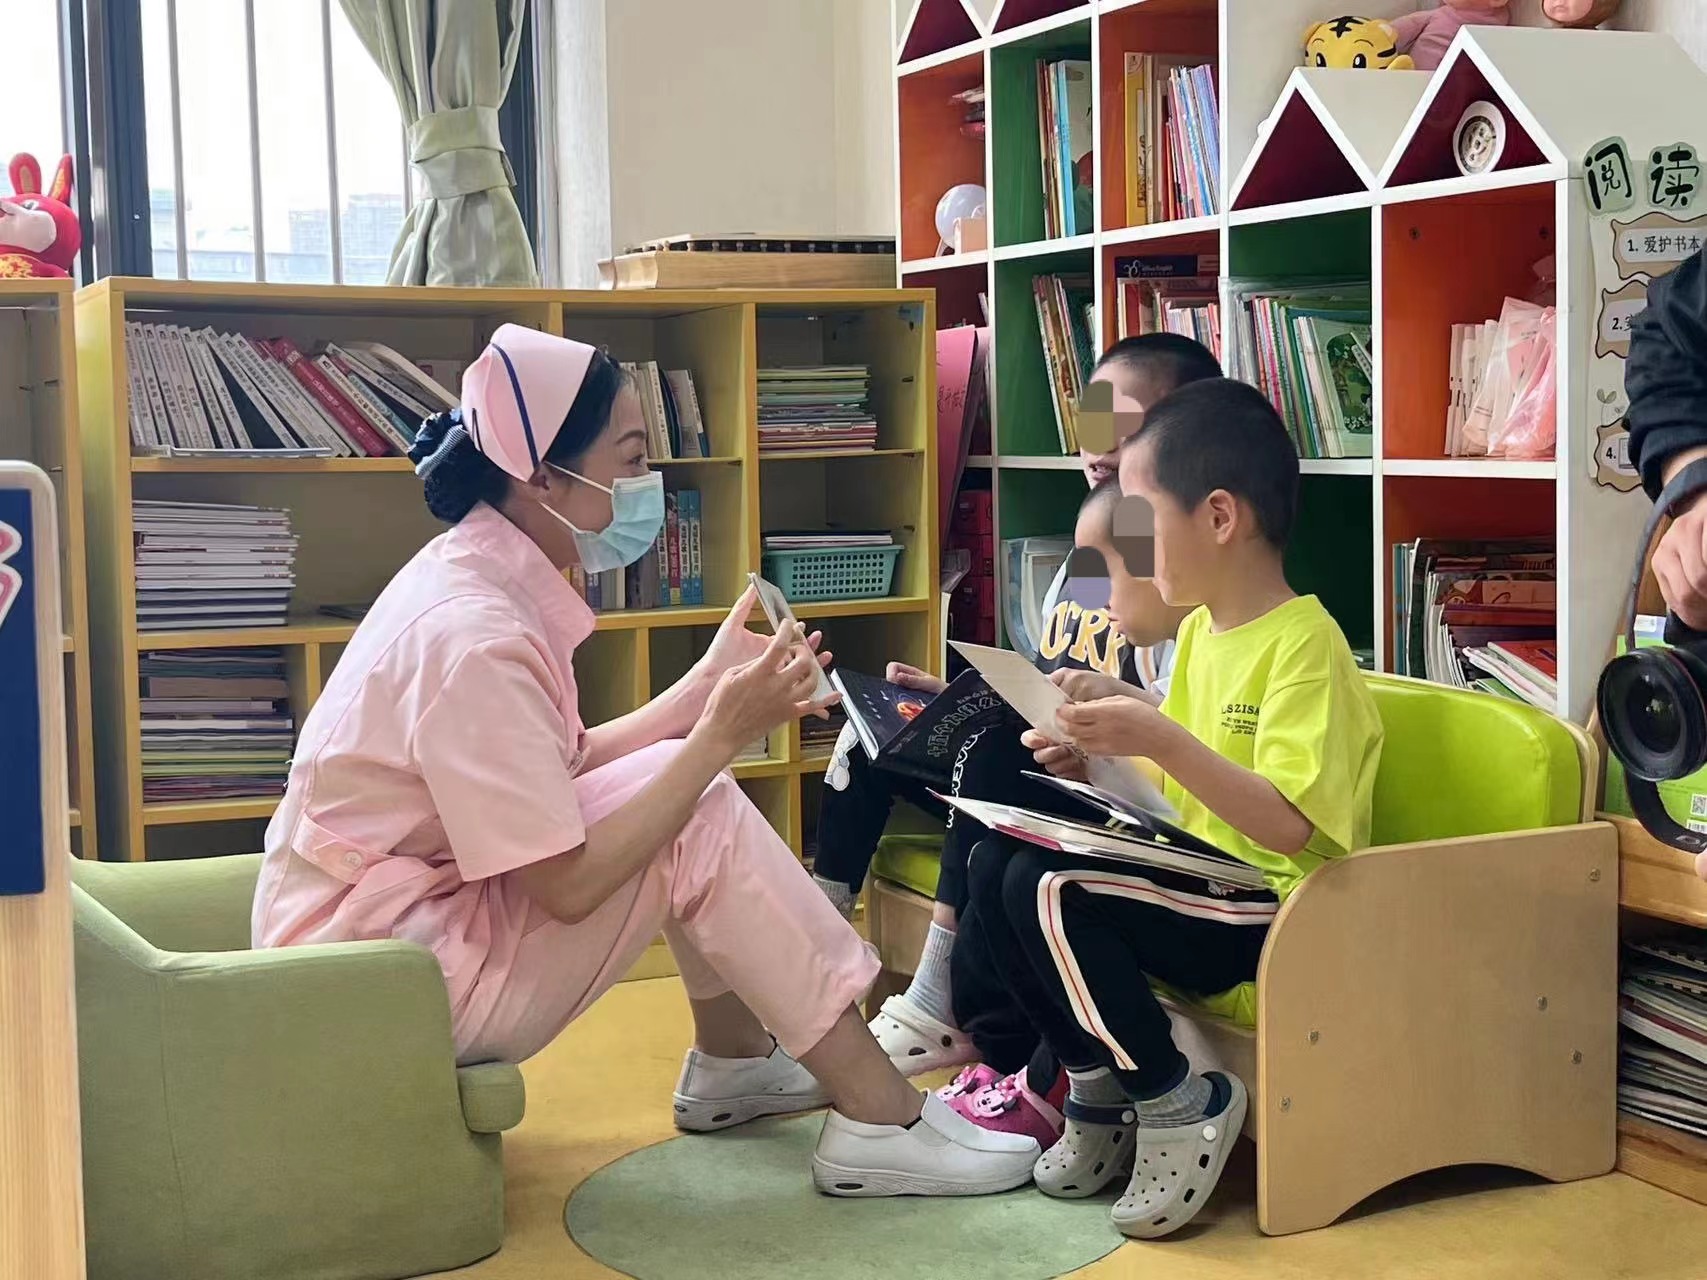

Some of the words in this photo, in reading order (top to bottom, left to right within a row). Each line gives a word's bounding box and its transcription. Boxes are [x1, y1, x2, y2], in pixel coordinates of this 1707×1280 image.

[1585, 143, 1699, 209] 阅读
[1627, 239, 1638, 252] 1.
[1606, 447, 1616, 459] 4.
